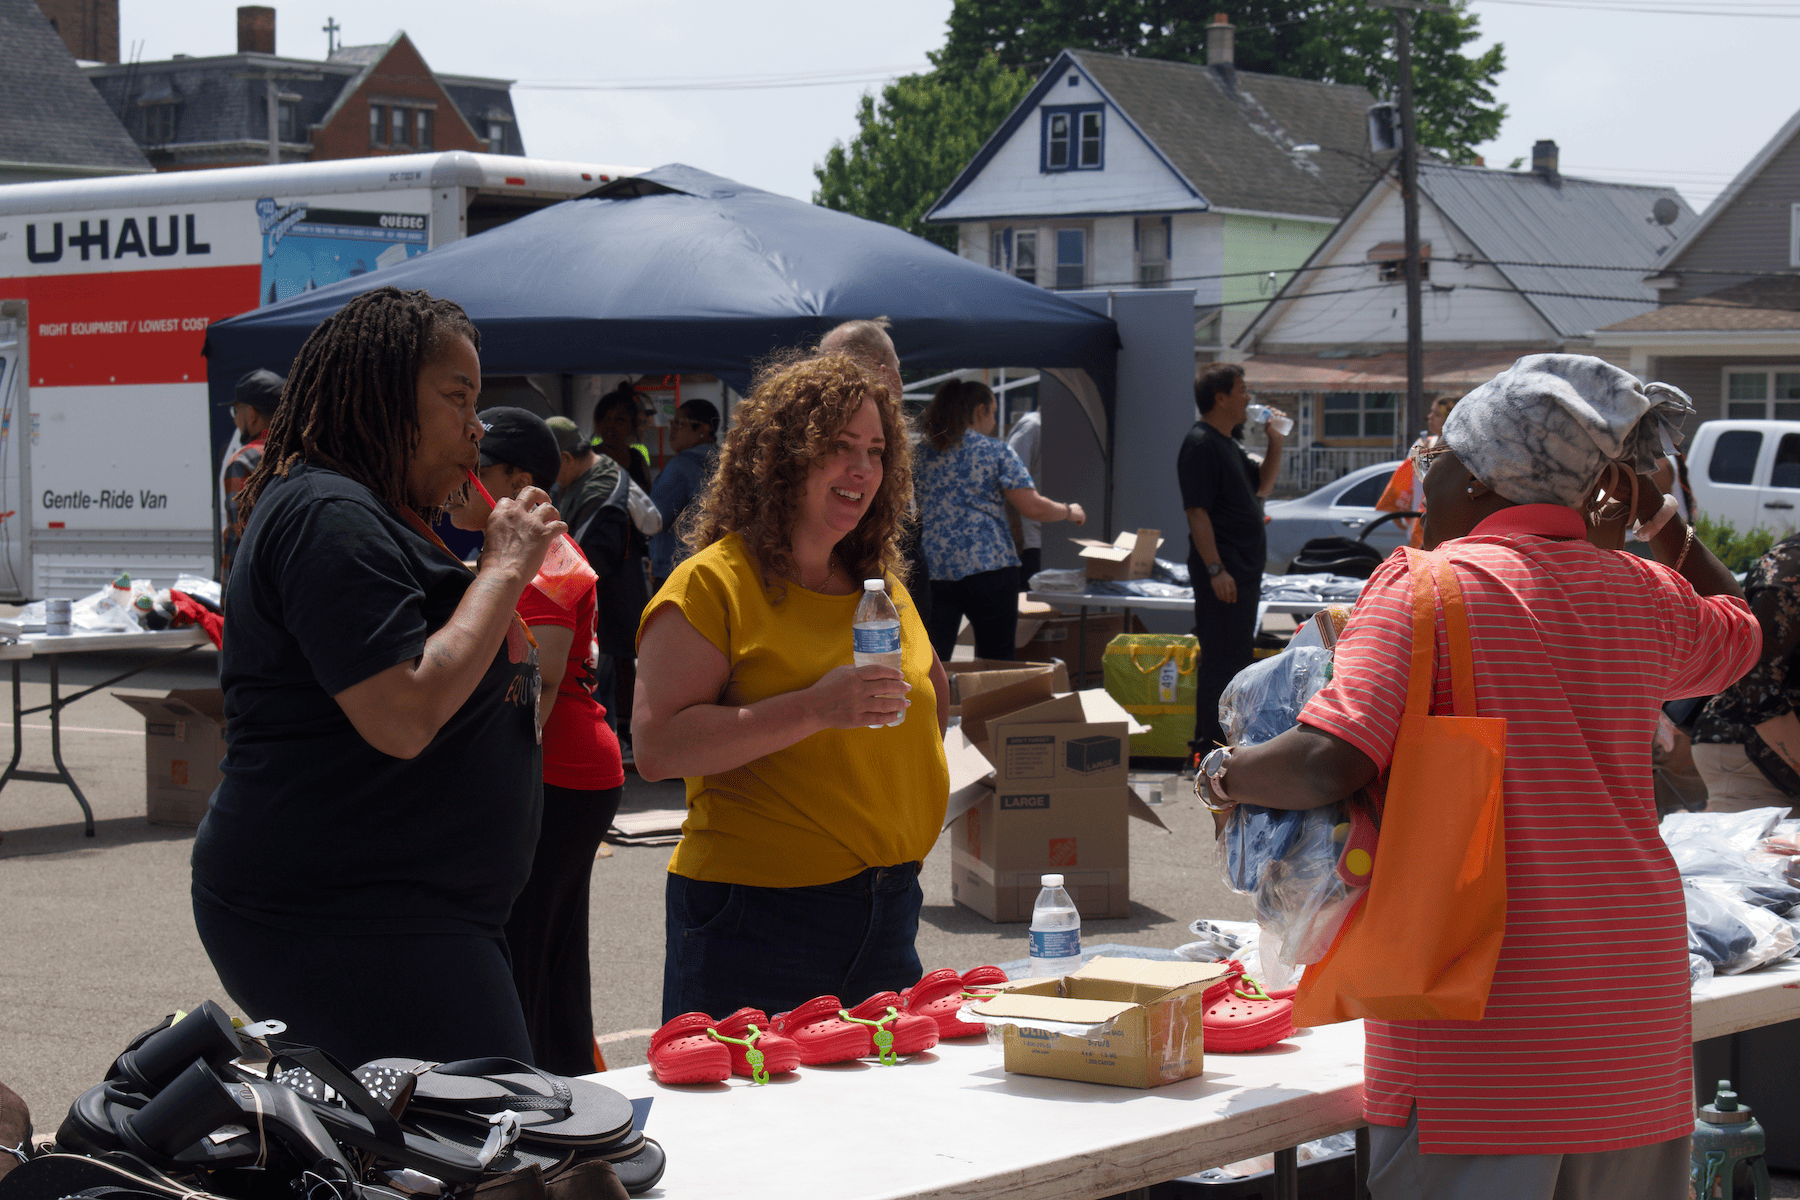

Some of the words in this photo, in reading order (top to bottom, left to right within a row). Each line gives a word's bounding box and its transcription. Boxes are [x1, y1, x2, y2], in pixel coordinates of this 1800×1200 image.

[39, 322, 69, 336] RIGHT
[71, 320, 128, 335] EQUIPMENT
[138, 318, 179, 333] LOWEST
[181, 317, 210, 331] COST
[42, 489, 134, 510] Gentle-Ride
[139, 490, 168, 510] Van
[1004, 796, 1045, 808] LARGE
